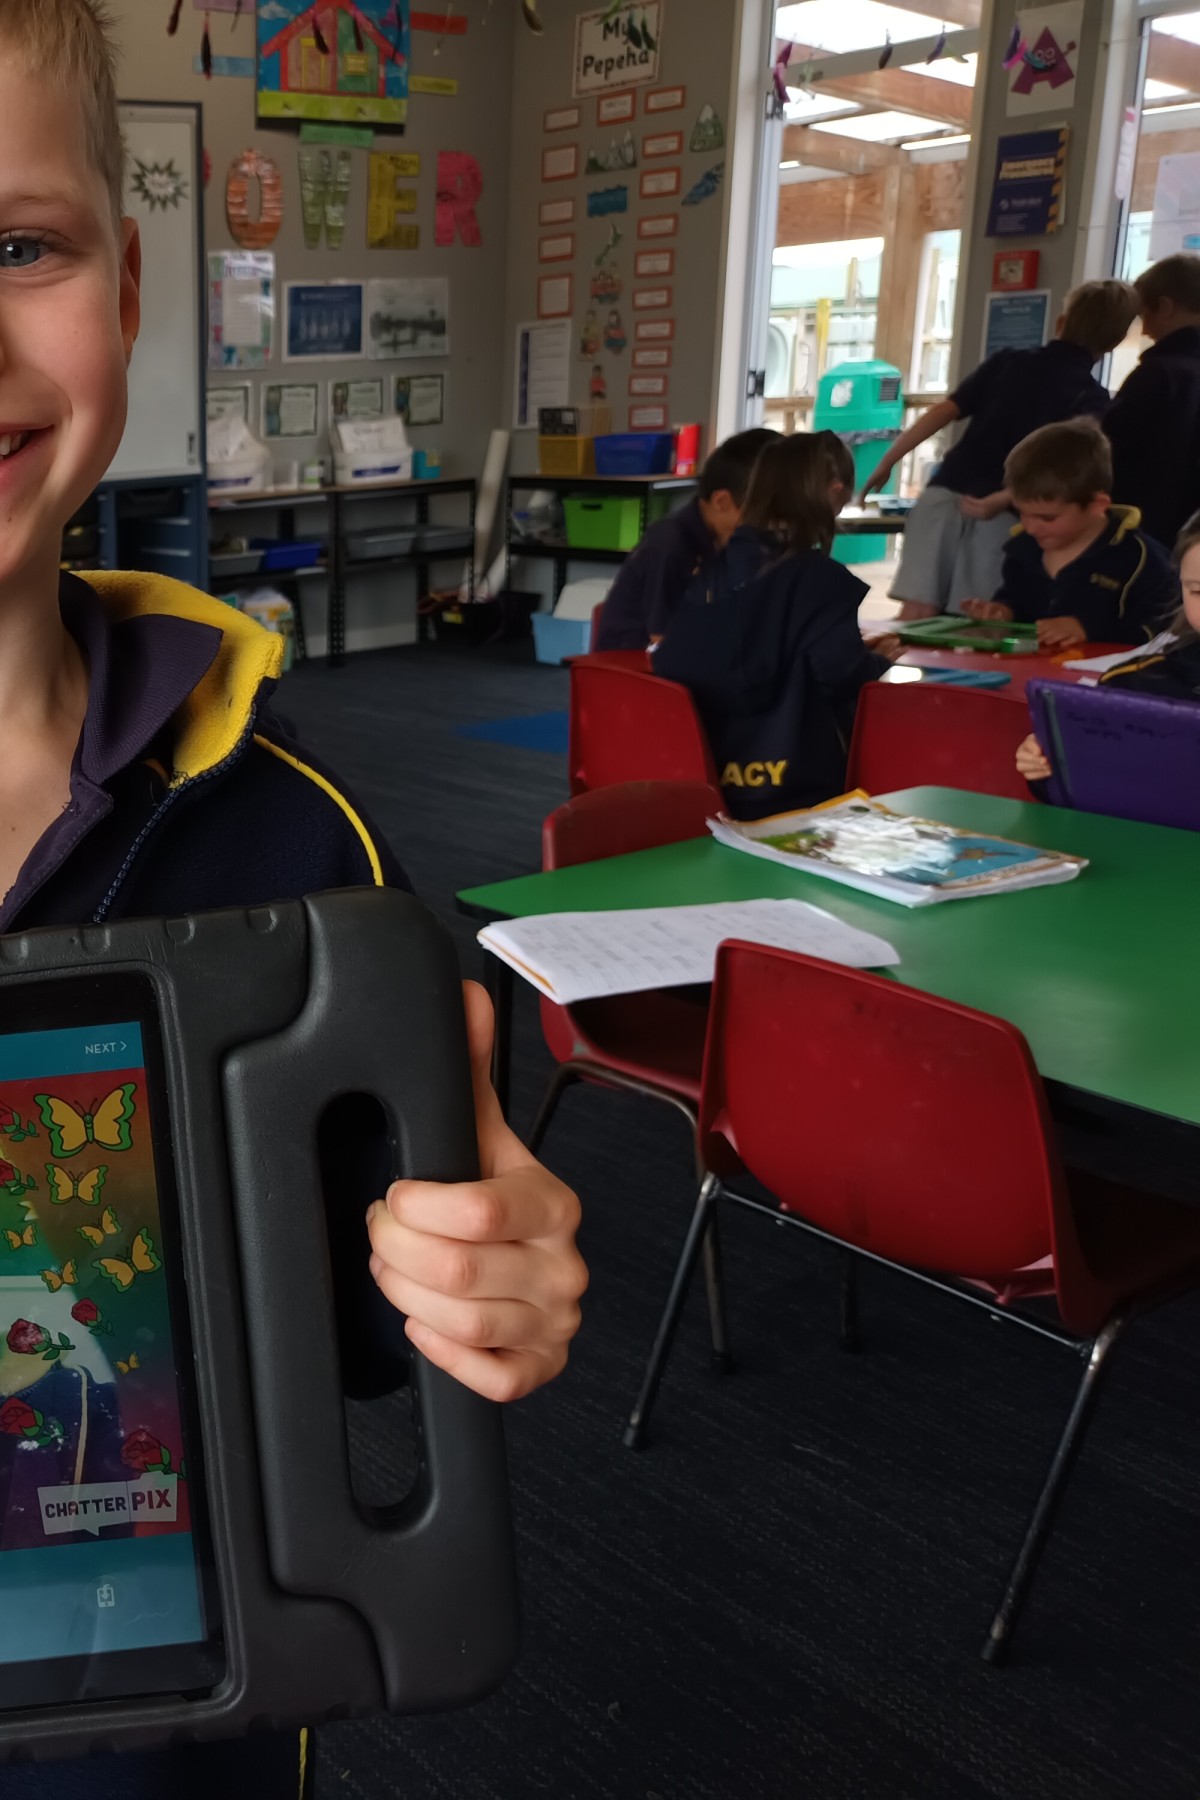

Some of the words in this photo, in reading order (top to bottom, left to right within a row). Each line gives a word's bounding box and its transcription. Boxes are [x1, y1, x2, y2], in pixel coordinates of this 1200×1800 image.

[602, 16, 630, 46] My
[582, 46, 650, 80] Pepeha
[720, 759, 788, 787] ACY
[85, 1042, 117, 1055] NEXT
[45, 1496, 127, 1518] CHATTER
[131, 1488, 172, 1511] PIX
